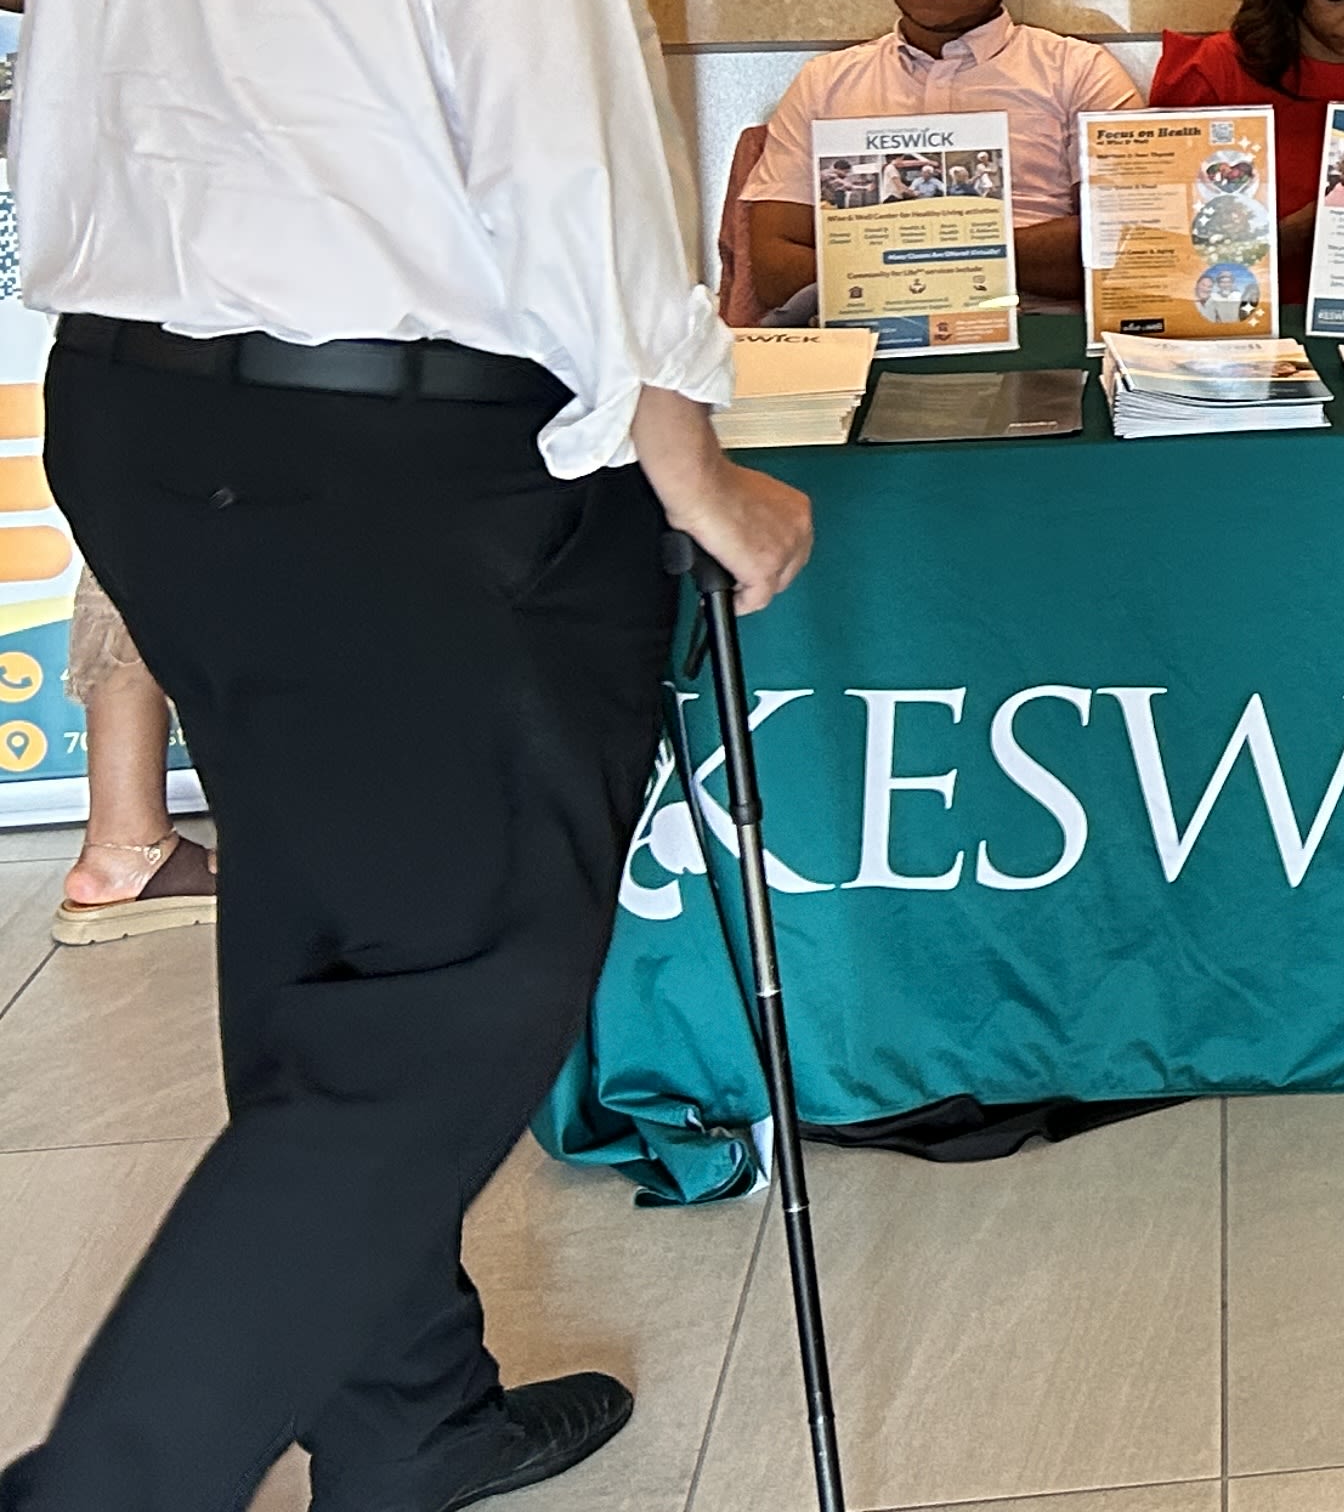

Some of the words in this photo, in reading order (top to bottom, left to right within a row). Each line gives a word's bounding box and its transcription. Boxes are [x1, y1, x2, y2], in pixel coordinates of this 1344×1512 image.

[866, 131, 954, 150] KESWICK
[1097, 129, 1134, 139] Focus
[1138, 129, 1154, 138] on
[1158, 127, 1201, 138] Health
